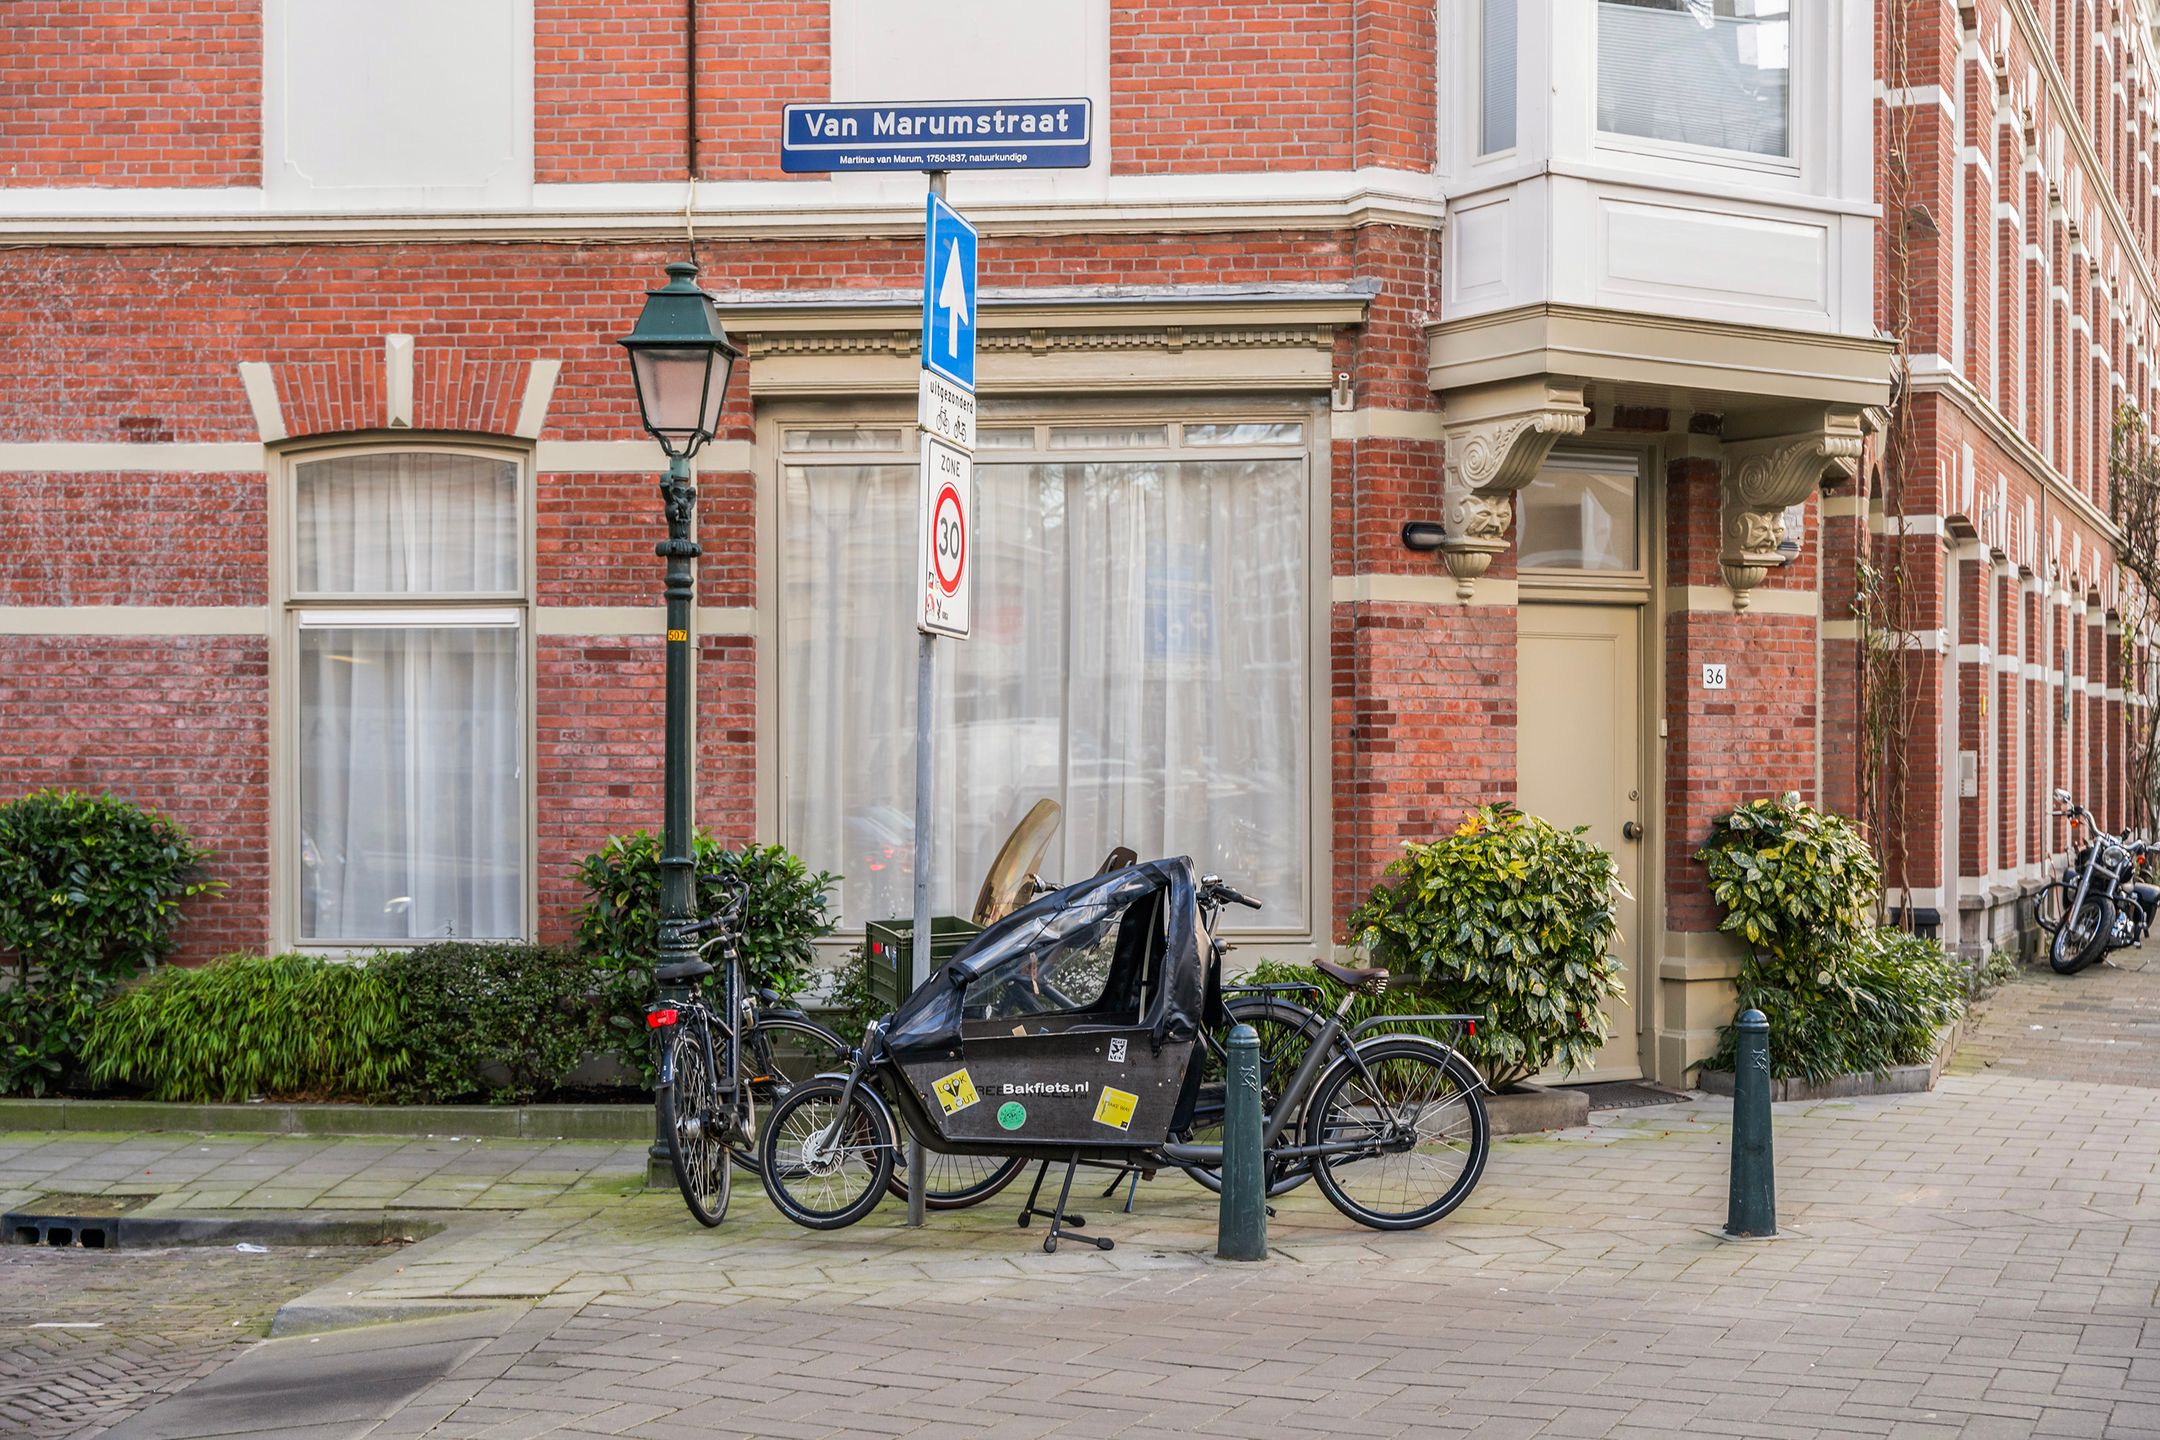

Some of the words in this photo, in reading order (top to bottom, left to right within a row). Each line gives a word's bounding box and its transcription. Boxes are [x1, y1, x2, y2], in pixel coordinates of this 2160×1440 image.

[804, 112, 858, 137] Van
[873, 108, 1069, 136] Marumstraat
[839, 154, 875, 165] Martinus
[876, 156, 892, 164] van
[893, 154, 924, 164] Marum,
[926, 153, 968, 163] 1750-1837,
[969, 152, 1028, 163] natuurkundige
[929, 380, 974, 415] uitgezonderd
[941, 454, 961, 478] ZONE
[938, 516, 960, 560] 30
[669, 630, 686, 640] 507
[1706, 668, 1723, 685] 36
[1002, 1081, 1089, 1095] Bakfiets.nl
